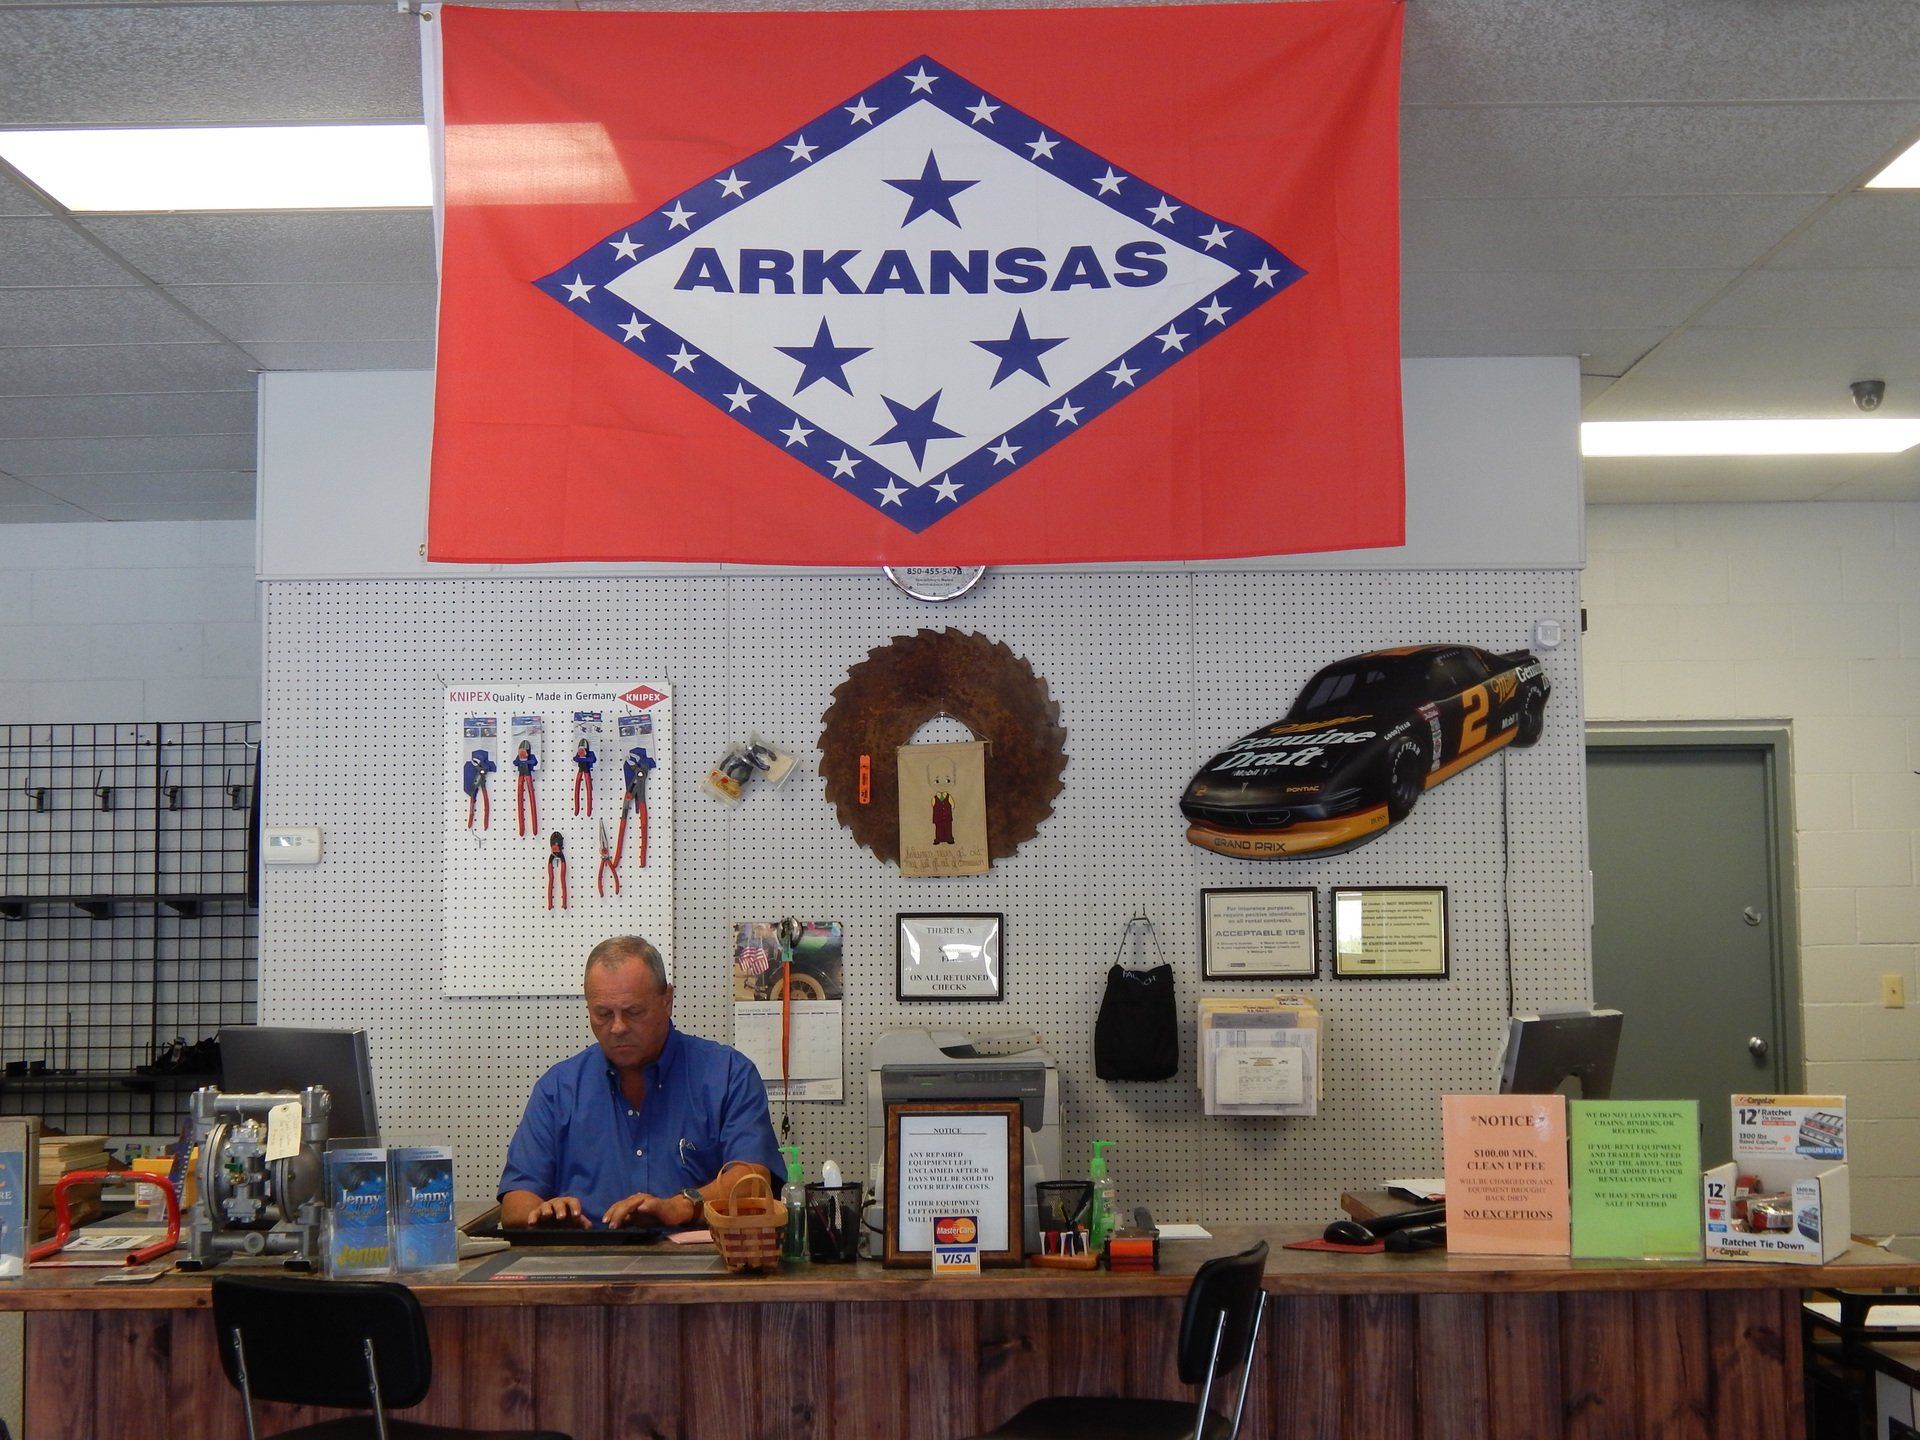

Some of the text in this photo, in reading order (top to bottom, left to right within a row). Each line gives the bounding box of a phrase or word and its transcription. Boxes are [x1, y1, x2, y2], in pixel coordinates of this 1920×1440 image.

[673, 241, 1168, 296] ARKANSAS
[450, 692, 617, 703] KNIPEX Quality Made in Germany
[626, 693, 660, 701] KNIPEX
[1459, 684, 1489, 754] 2
[1226, 728, 1377, 752] Genuine
[1211, 747, 1325, 771] Draft
[1233, 769, 1260, 777] Mobil
[1286, 785, 1320, 793] PONTIAC
[1214, 837, 1286, 851] GRAND PRIX
[1747, 1097, 1776, 1105] CargoLoc
[1739, 1109, 1760, 1125] 12'
[933, 1127, 962, 1135] NOTICE
[1474, 1149, 1537, 1158] $100.00 MIN.
[1467, 1161, 1546, 1171] CLEAN UP FEE
[1708, 1183, 1726, 1198] 12'
[336, 1188, 380, 1209] Jenny
[406, 1186, 449, 1207] Jenny
[1463, 1209, 1553, 1219] NO EXCEPTIONS
[936, 1226, 975, 1235] MasterCard
[1722, 1238, 1805, 1250] Ratchet Tie Down
[1720, 1248, 1749, 1257] CargoLoc
[942, 1254, 971, 1264] VISA
